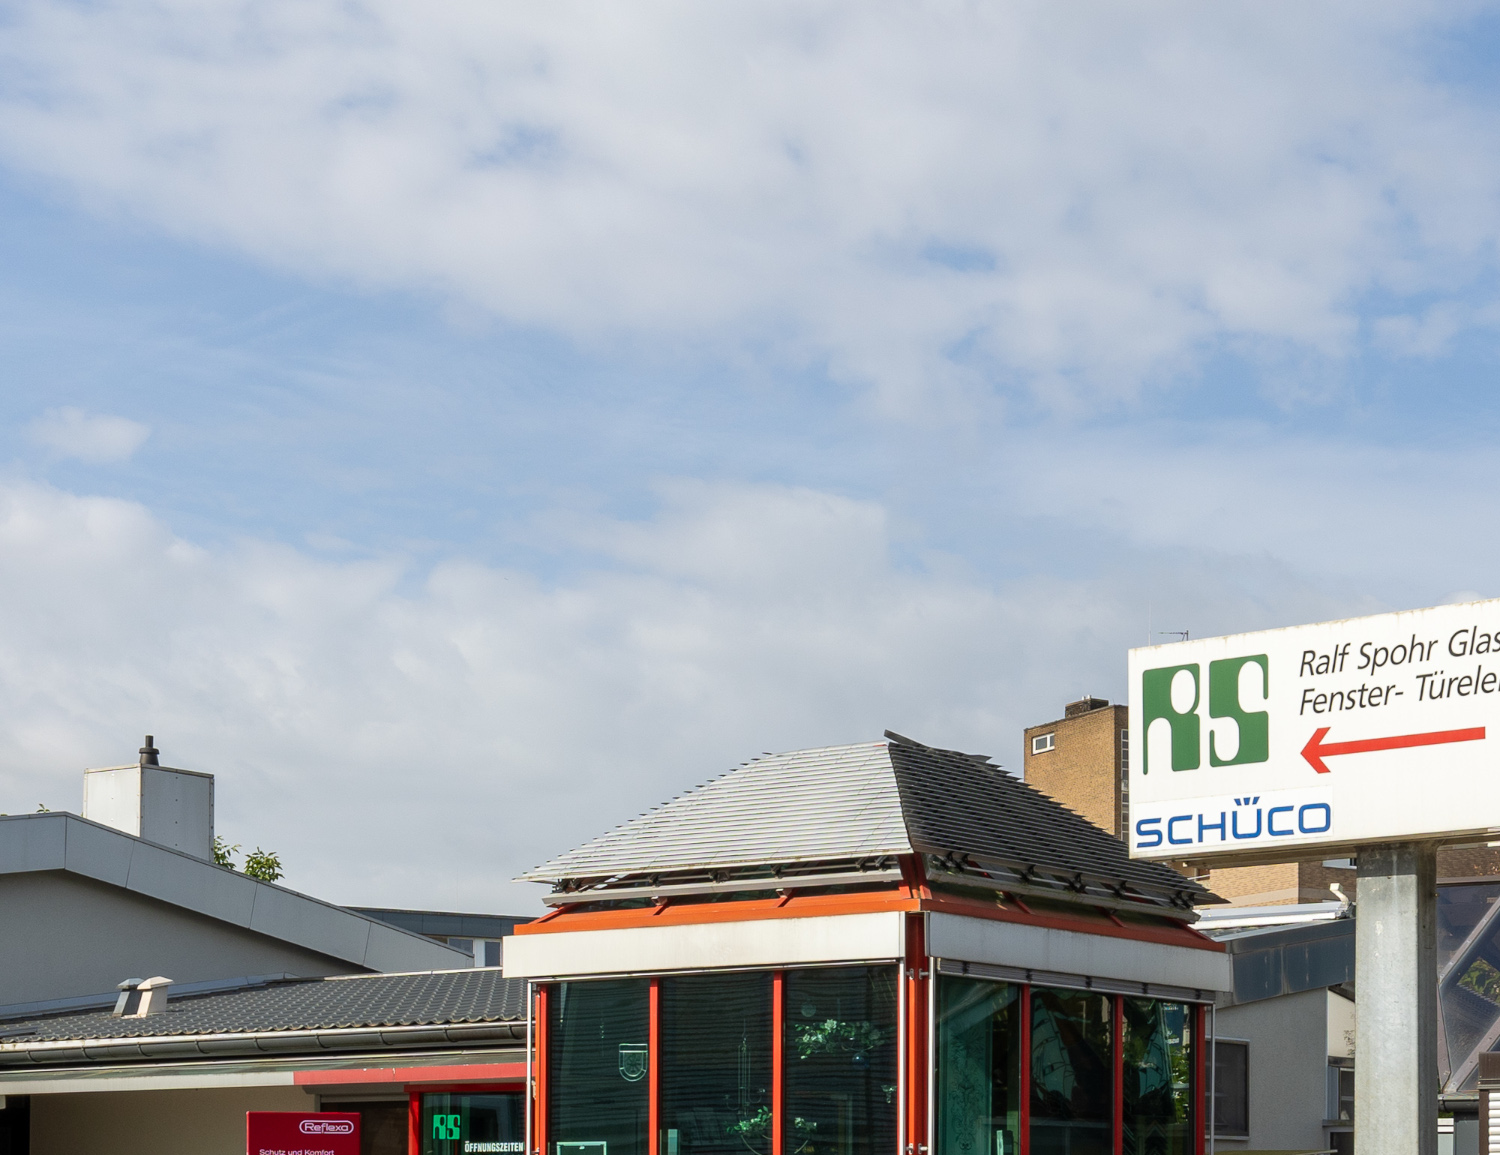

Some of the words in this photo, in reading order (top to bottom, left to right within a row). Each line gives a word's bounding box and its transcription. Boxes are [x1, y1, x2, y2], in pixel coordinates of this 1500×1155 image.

[1299, 642, 1351, 678] Ralf
[1357, 635, 1438, 672] Spohr
[1299, 679, 1404, 715] Fenster-
[1136, 796, 1331, 848] SCHÜCO
[304, 1122, 349, 1133] Reflexa
[464, 1140, 524, 1152] ÖFFNUNGSZEITEN
